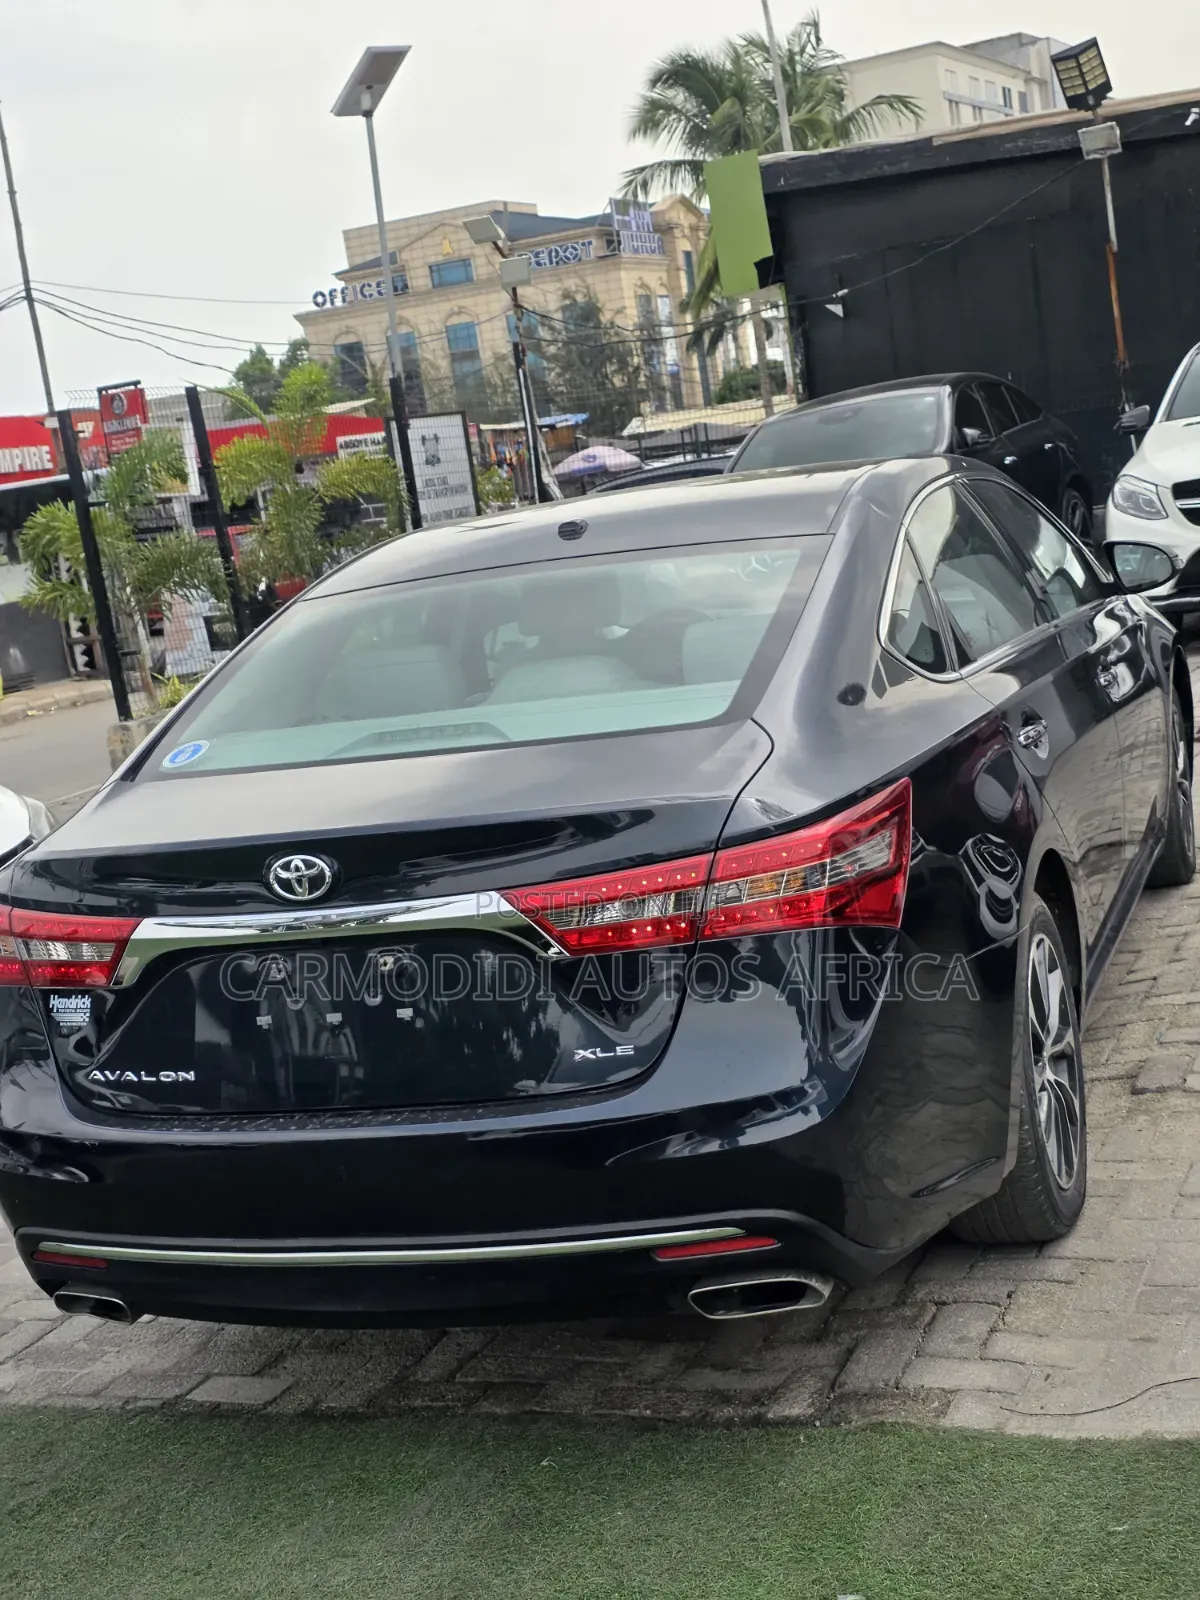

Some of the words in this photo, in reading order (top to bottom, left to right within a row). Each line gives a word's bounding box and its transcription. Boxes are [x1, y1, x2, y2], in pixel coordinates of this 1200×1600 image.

[49, 994, 92, 1013] Hendrick
[573, 1044, 635, 1062] XLE
[87, 1070, 196, 1082] AVALON
